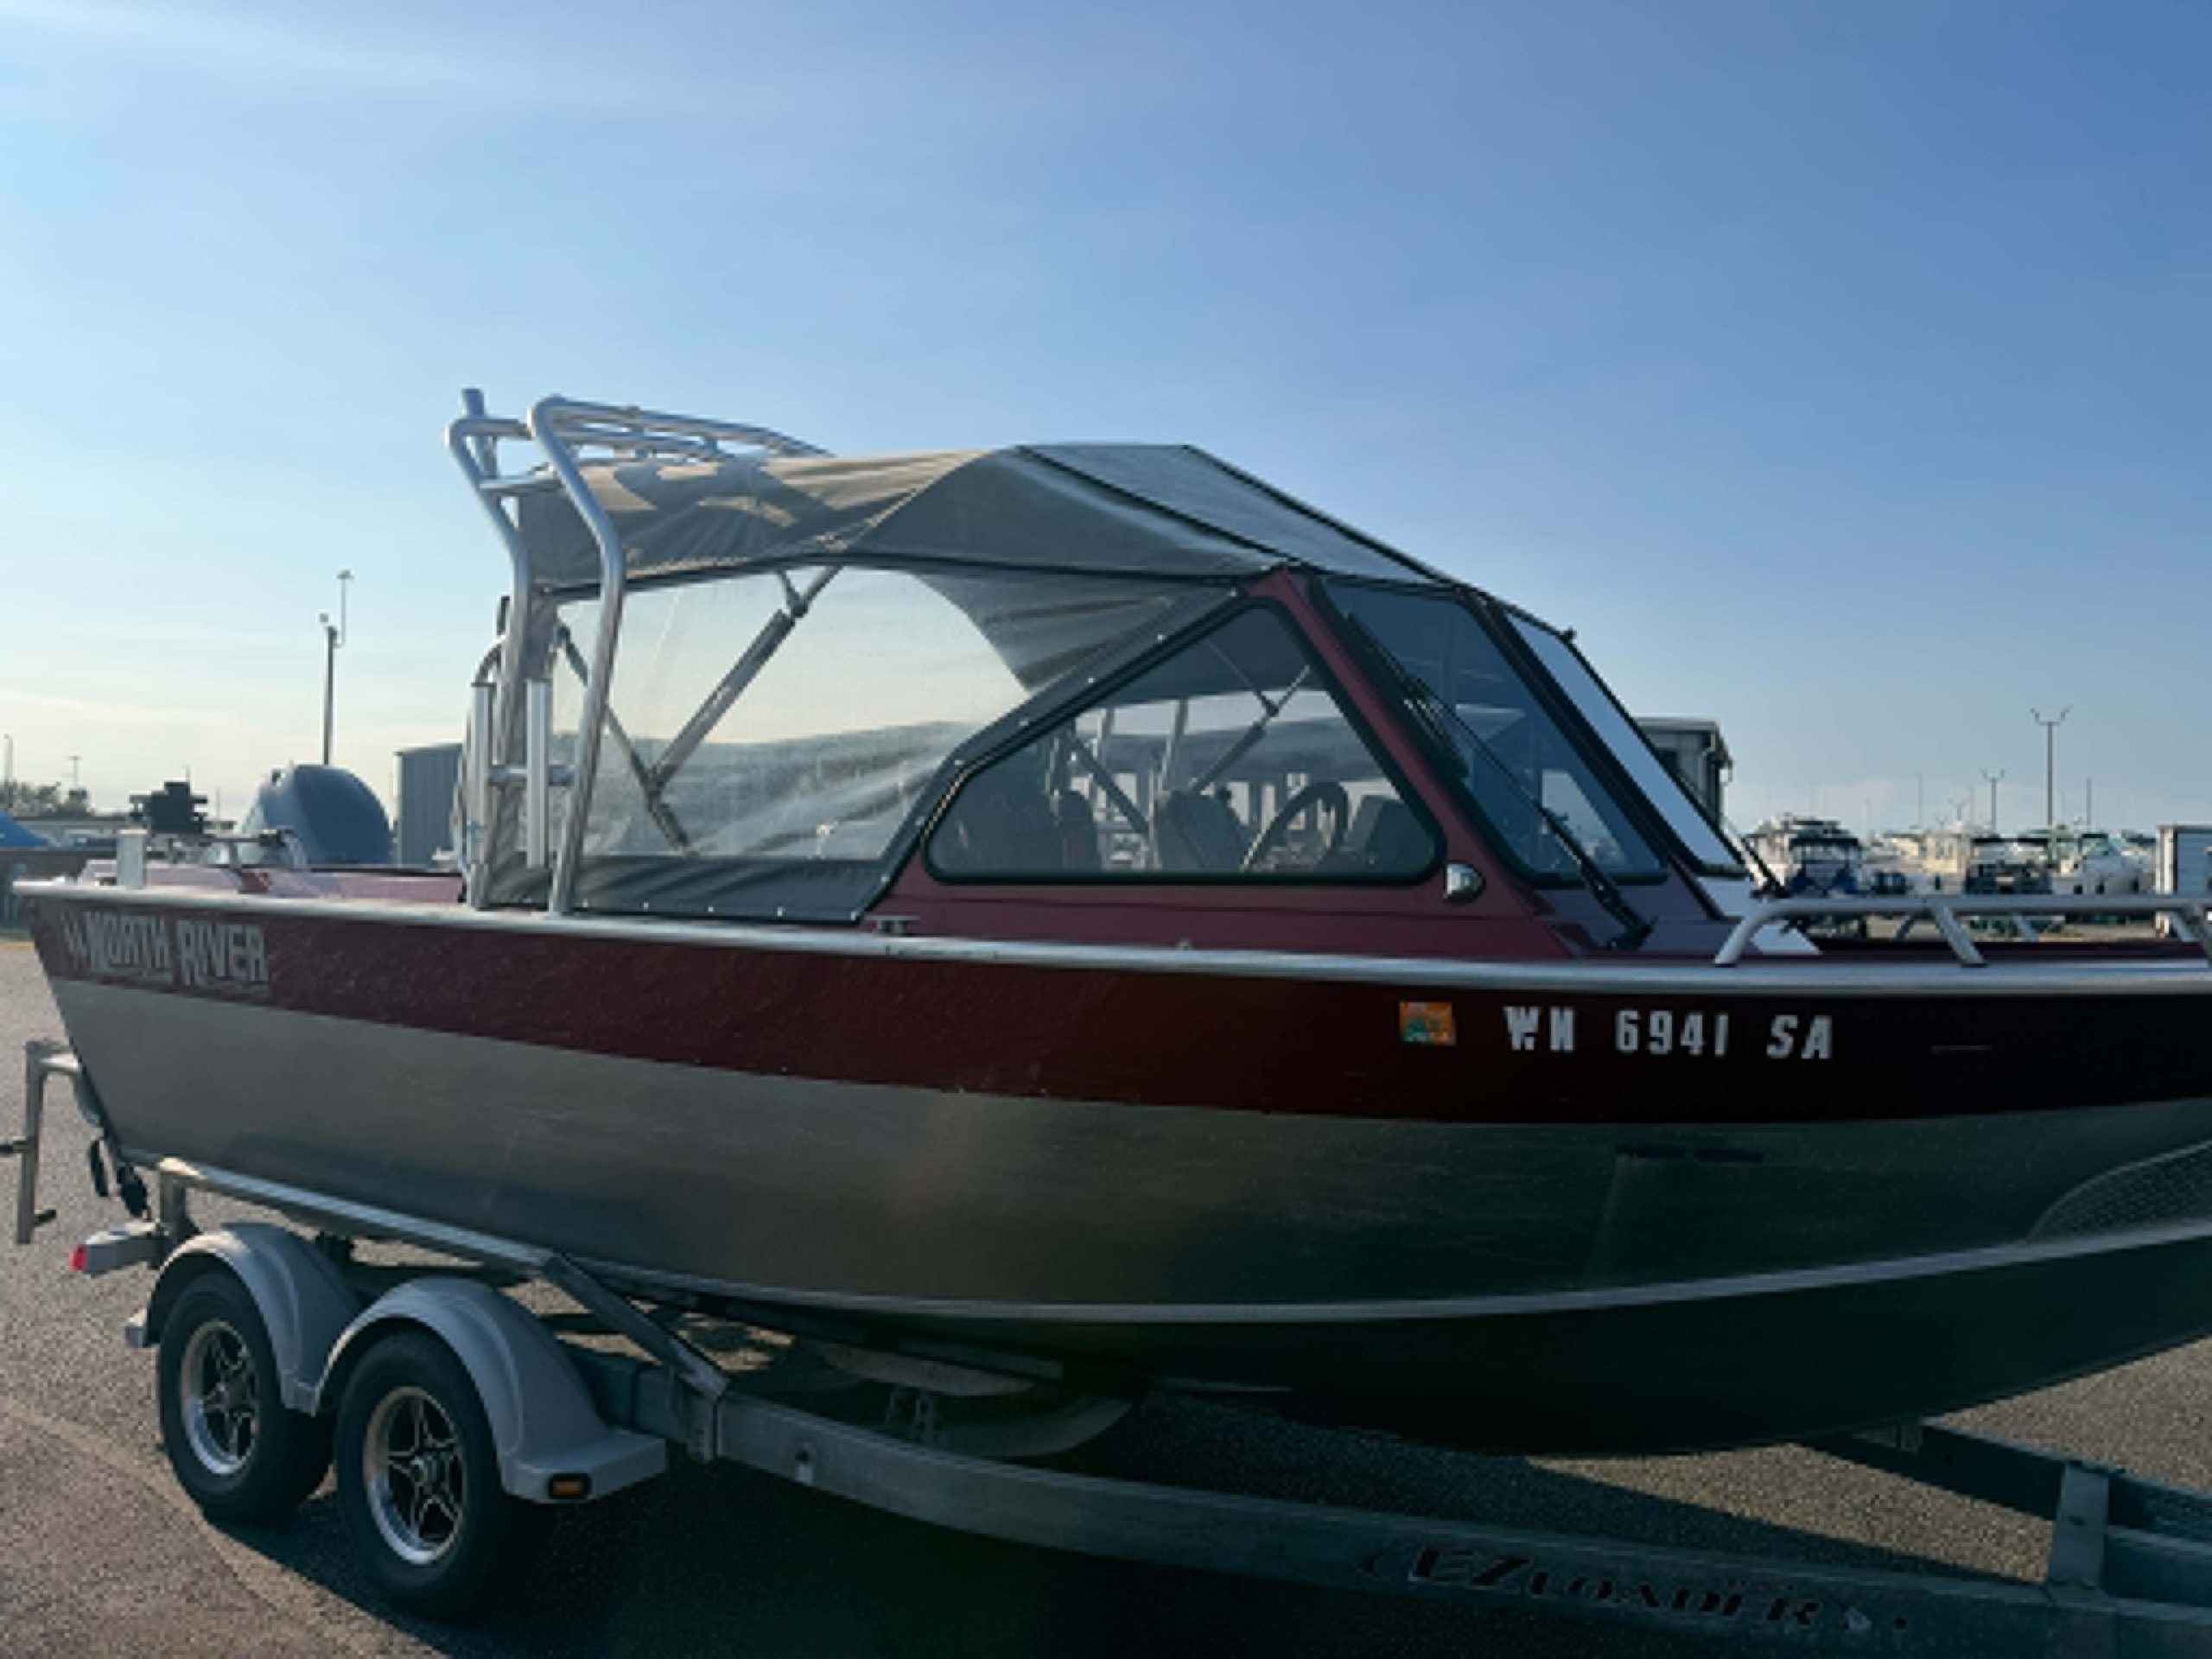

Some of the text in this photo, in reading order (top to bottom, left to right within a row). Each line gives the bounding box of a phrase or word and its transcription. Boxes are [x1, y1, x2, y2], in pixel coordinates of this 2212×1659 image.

[86, 911, 269, 987] NORTH RIVER
[1503, 1006, 1575, 1052] WN
[1615, 1009, 1730, 1056] 6941
[1767, 1014, 1833, 1060] SA
